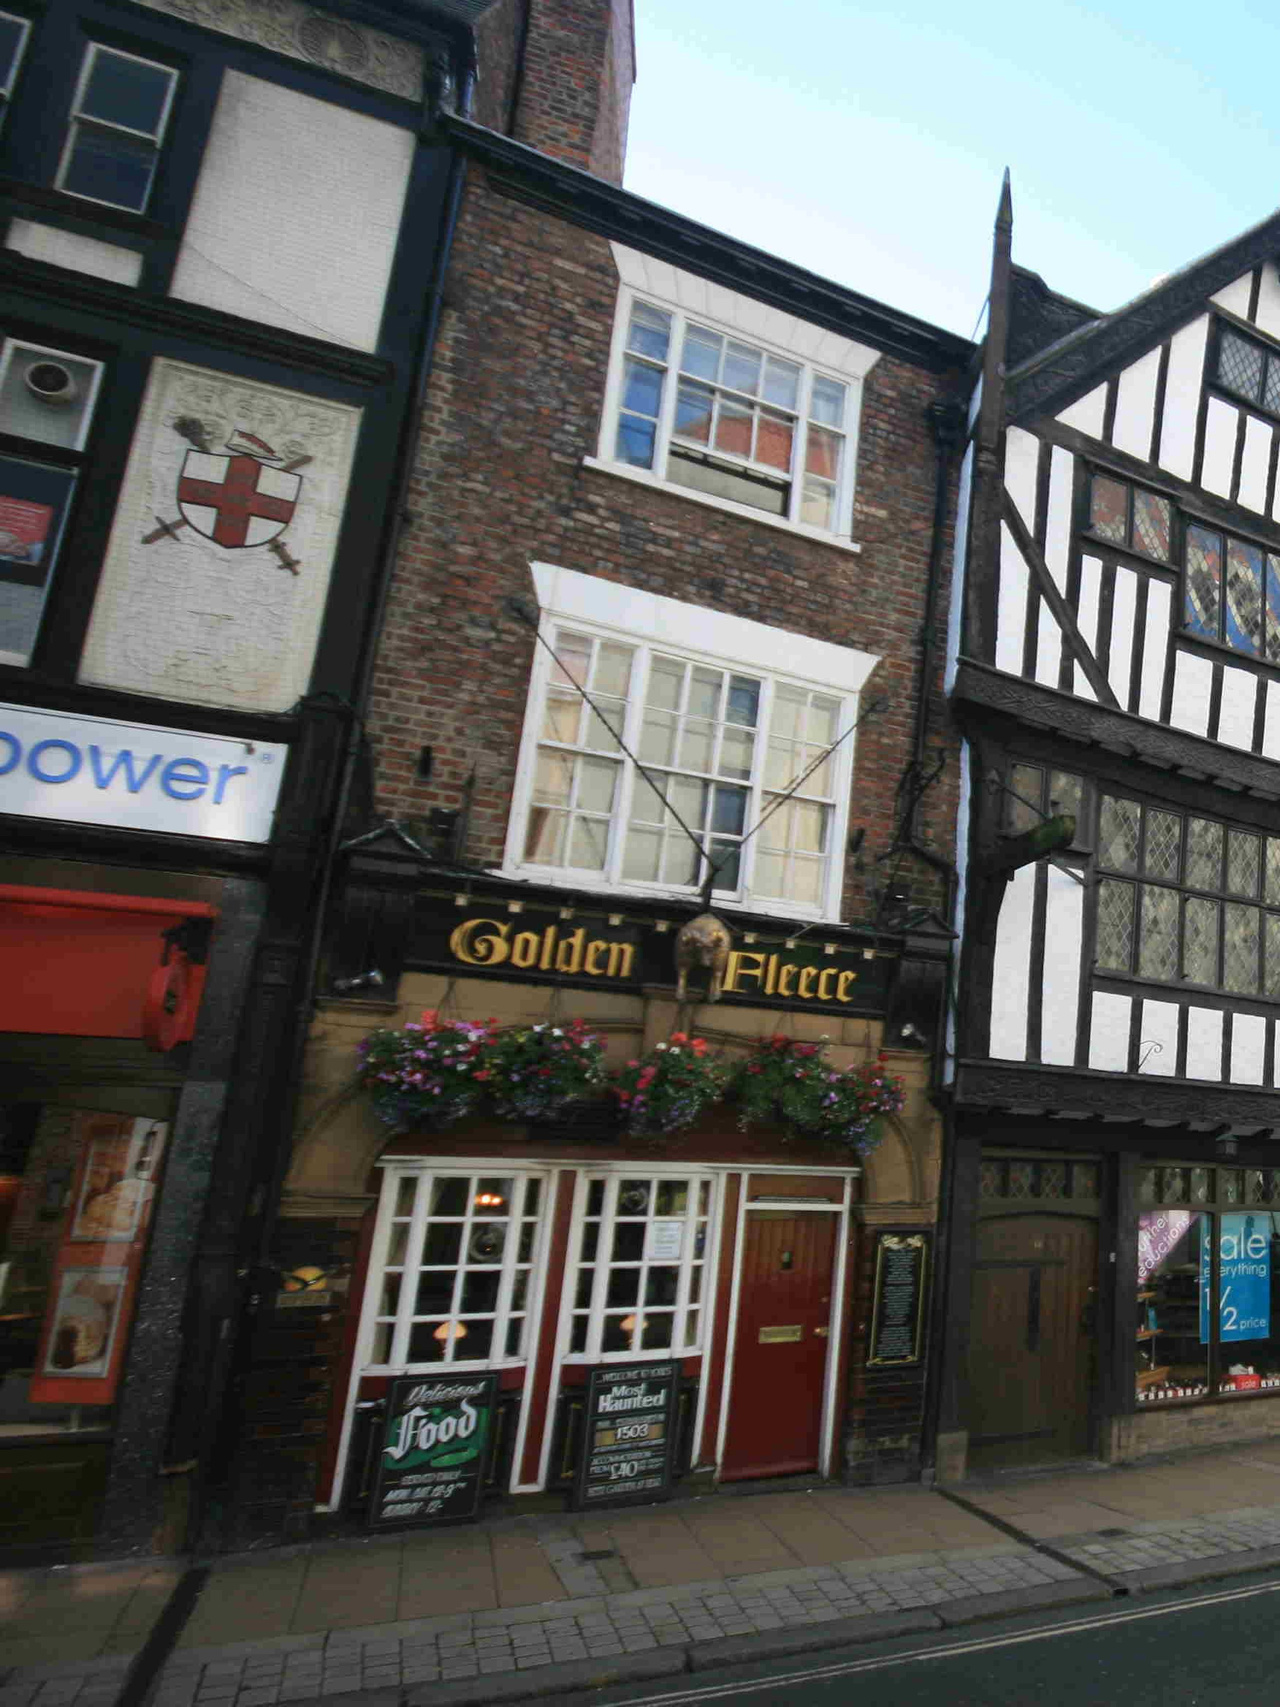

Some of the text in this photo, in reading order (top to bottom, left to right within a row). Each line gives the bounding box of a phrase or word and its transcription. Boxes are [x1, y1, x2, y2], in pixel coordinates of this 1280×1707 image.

[449, 917, 857, 1003] Golden Fleece
[1204, 1263, 1267, 1280] eerything
[404, 1381, 487, 1406] Delicious
[597, 1389, 667, 1413] Haunted
[611, 1383, 647, 1398] Most
[381, 1397, 478, 1460] Food
[616, 1424, 648, 1440] 1503
[608, 1461, 638, 1480] £40
